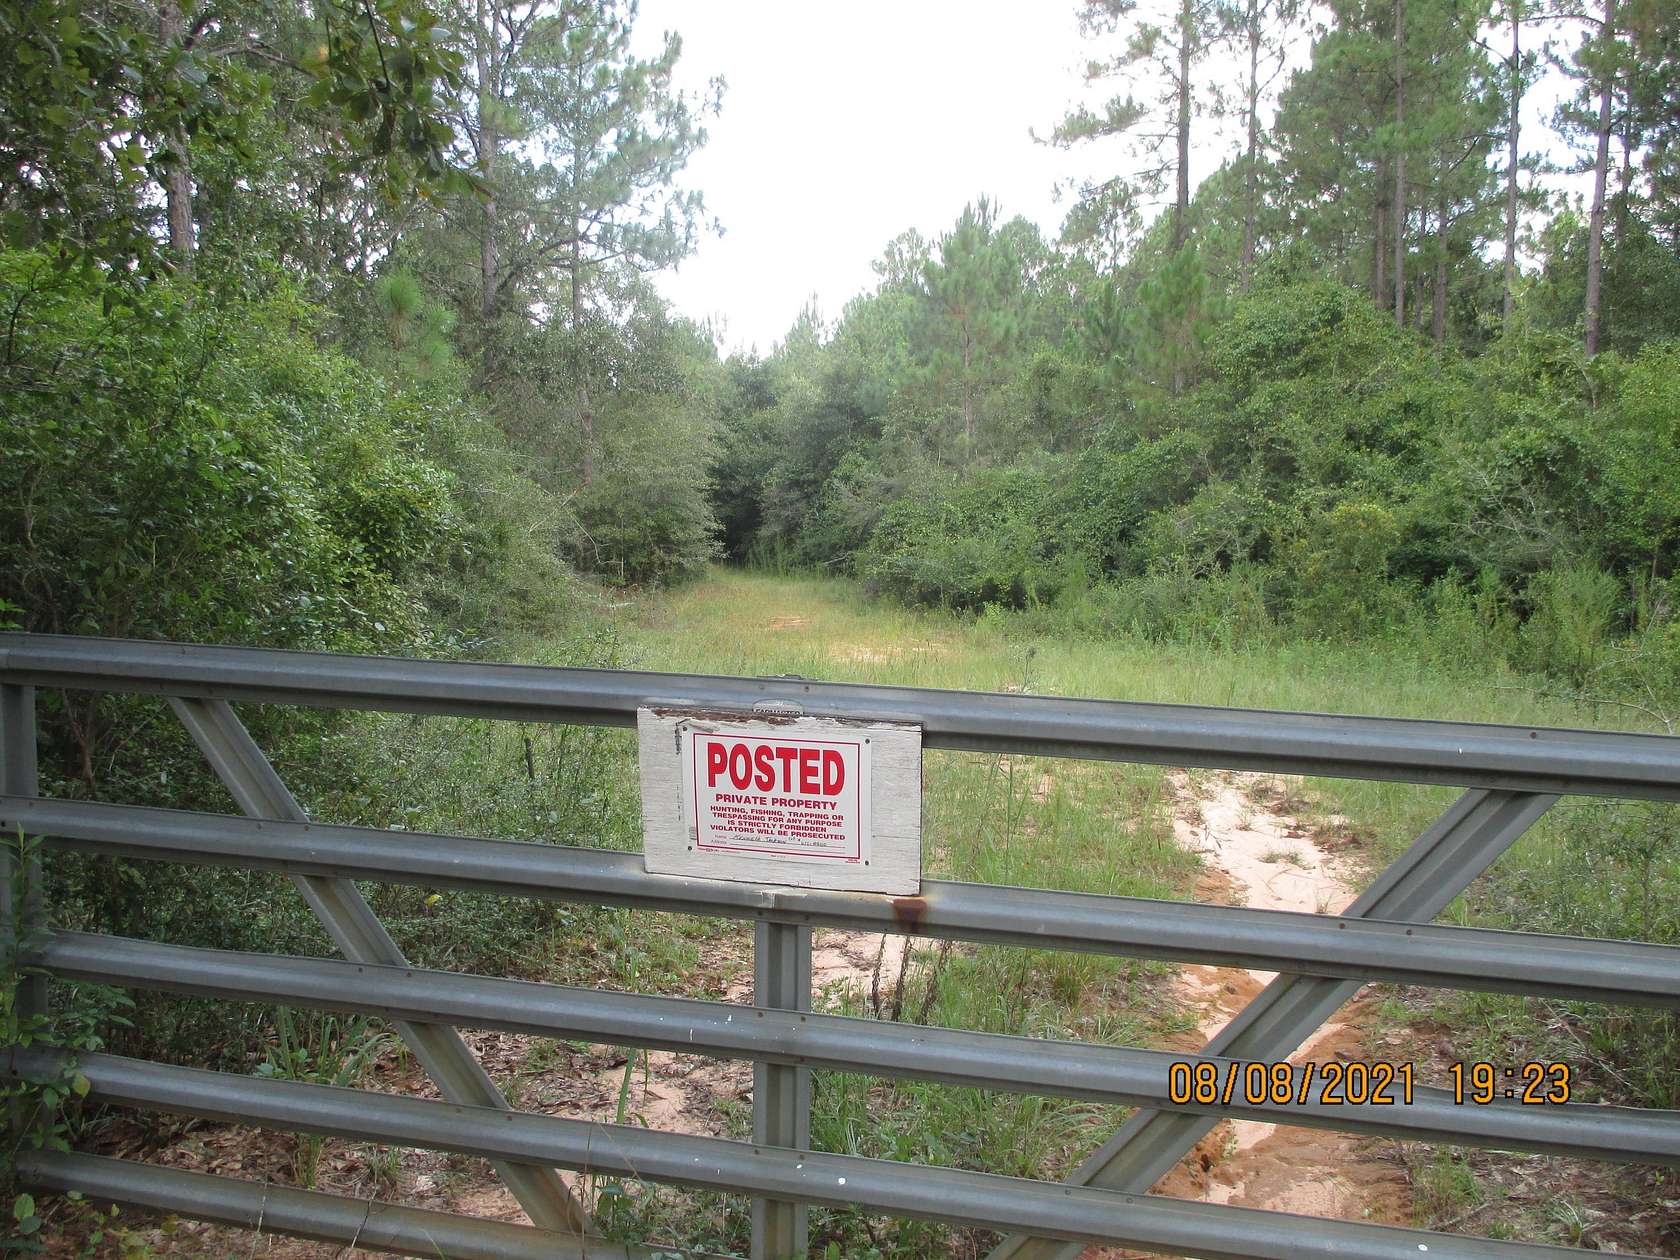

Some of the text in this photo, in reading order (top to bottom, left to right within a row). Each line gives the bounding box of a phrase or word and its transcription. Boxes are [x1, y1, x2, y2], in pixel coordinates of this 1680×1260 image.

[707, 742, 845, 796] POSTED
[715, 793, 837, 810] PRIVATE PROPERTY
[710, 805, 748, 815] HUNTING,
[750, 808, 785, 818] FISHING,
[788, 811, 829, 820] TRAPPING
[712, 812, 765, 822] TRESPASSING
[768, 816, 784, 824] FOR
[805, 819, 843, 828] PURPOSE
[710, 824, 754, 834] VIOLATORS
[757, 828, 775, 836] WILL
[791, 831, 846, 841] PROSECUTED
[738, 820, 776, 829] STRICTLY
[779, 824, 827, 833] FORBIDDEN
